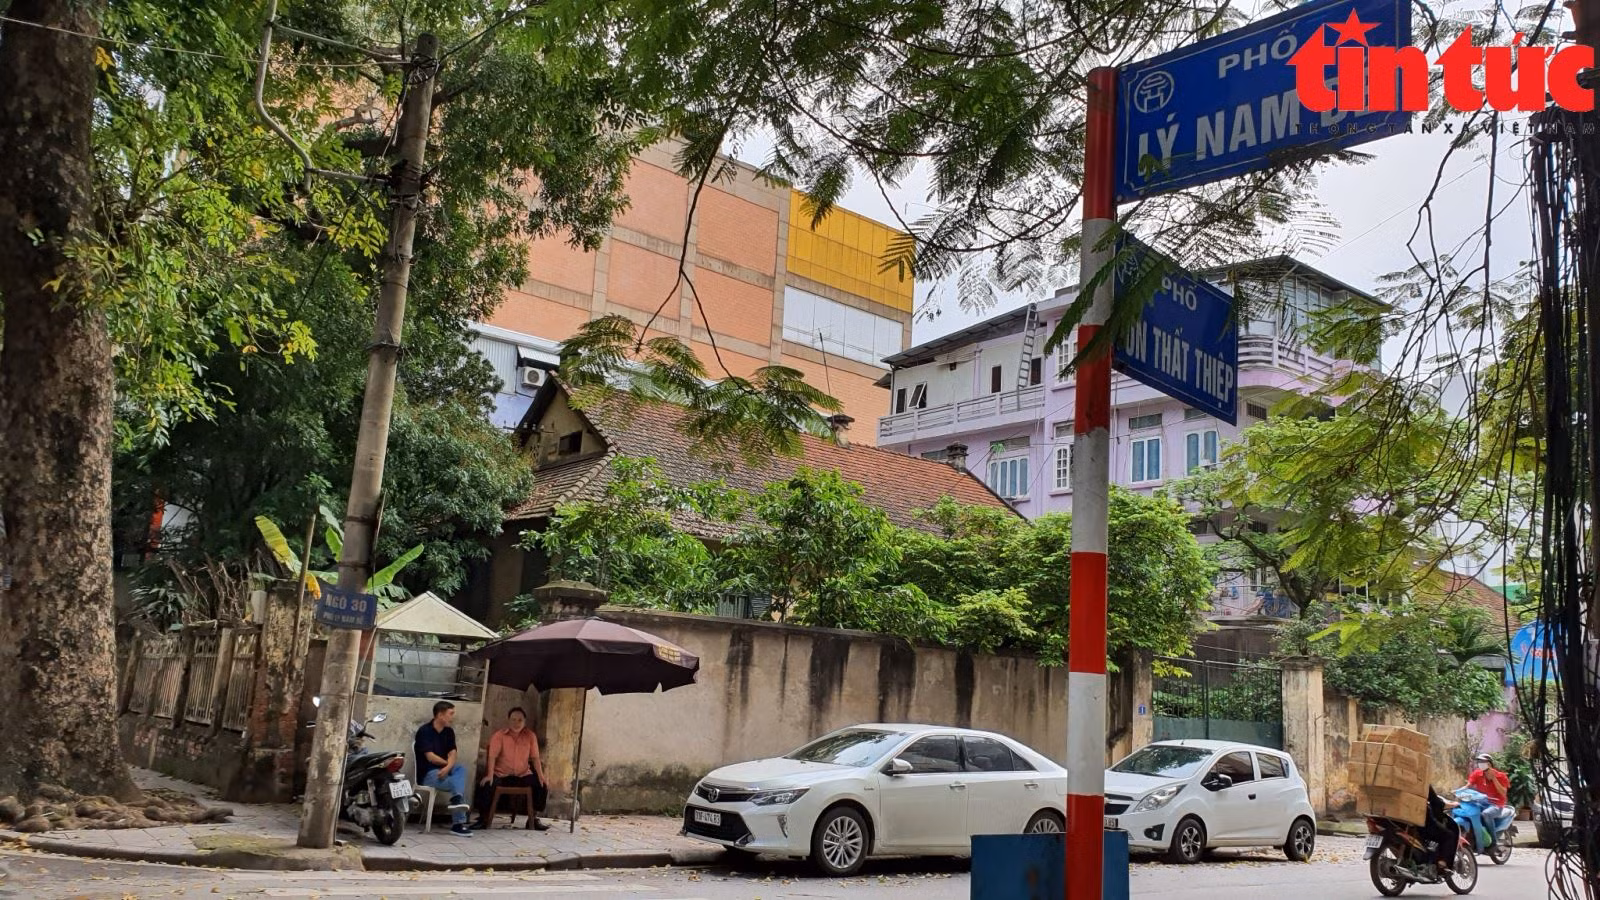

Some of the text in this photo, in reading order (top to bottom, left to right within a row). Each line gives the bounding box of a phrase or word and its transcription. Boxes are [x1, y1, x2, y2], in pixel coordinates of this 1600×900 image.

[1218, 22, 1298, 79] PHỐ
[1137, 112, 1181, 177] LÝ
[1195, 88, 1300, 162] NAM
[1153, 326, 1190, 383] THẤT
[1194, 349, 1234, 408] THIỆP
[351, 599, 368, 613] 30
